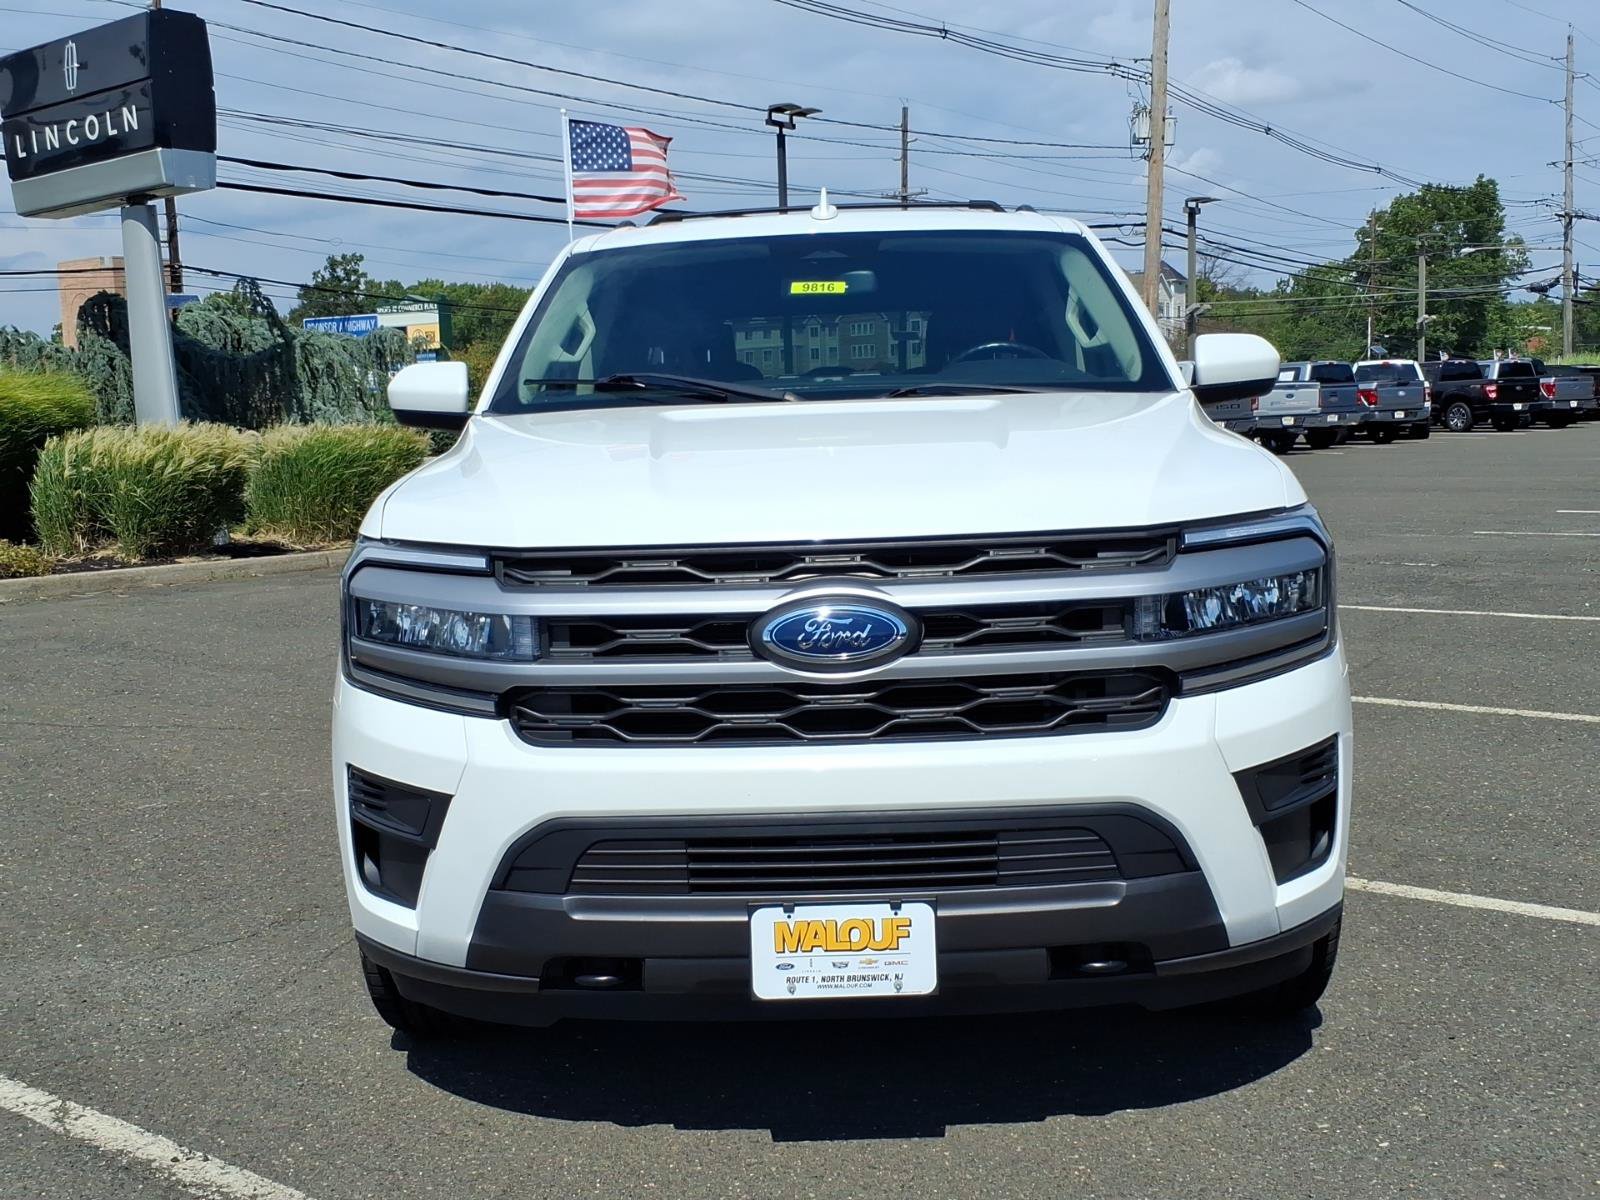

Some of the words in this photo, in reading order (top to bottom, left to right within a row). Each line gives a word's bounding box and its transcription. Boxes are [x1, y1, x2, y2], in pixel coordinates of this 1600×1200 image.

[16, 105, 138, 158] LINCOLN
[802, 283, 835, 292] 9816
[798, 616, 872, 649] Ford
[774, 918, 912, 953] MALOUF
[786, 976, 810, 984] ROUTE
[811, 976, 818, 984] 1,
[821, 975, 845, 983] NORTH
[847, 973, 892, 983] BRUNSWICK,
